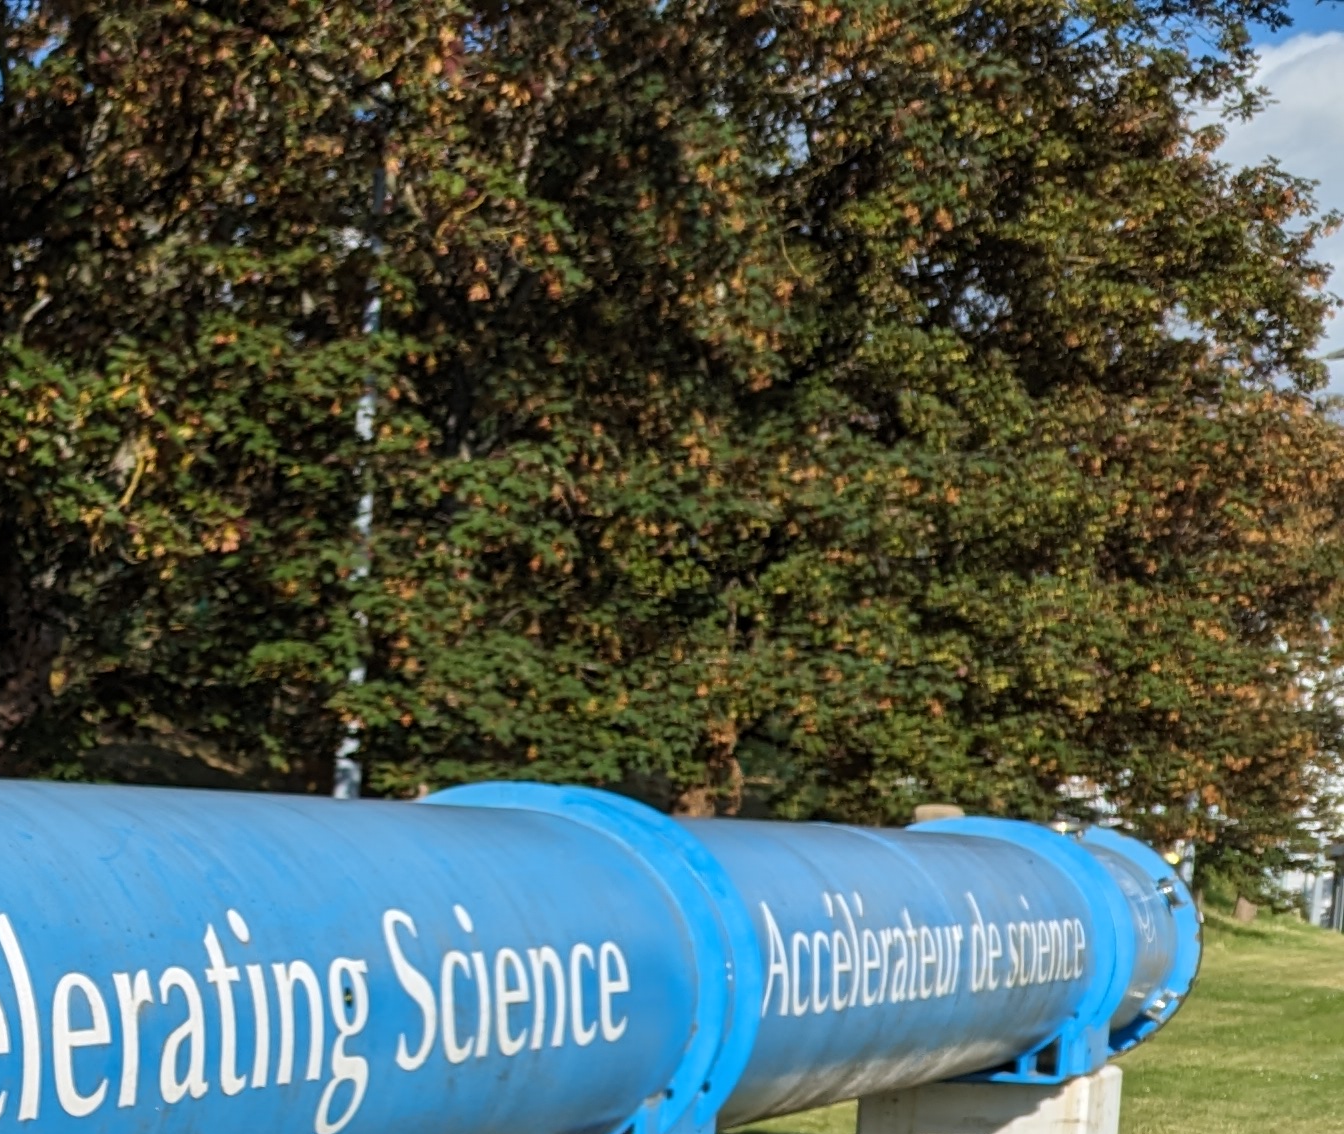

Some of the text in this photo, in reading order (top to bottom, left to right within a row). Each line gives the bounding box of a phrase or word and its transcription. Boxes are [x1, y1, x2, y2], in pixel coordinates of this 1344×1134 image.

[382, 903, 631, 1072] Science
[760, 891, 1087, 1018] Accélérateur de science
